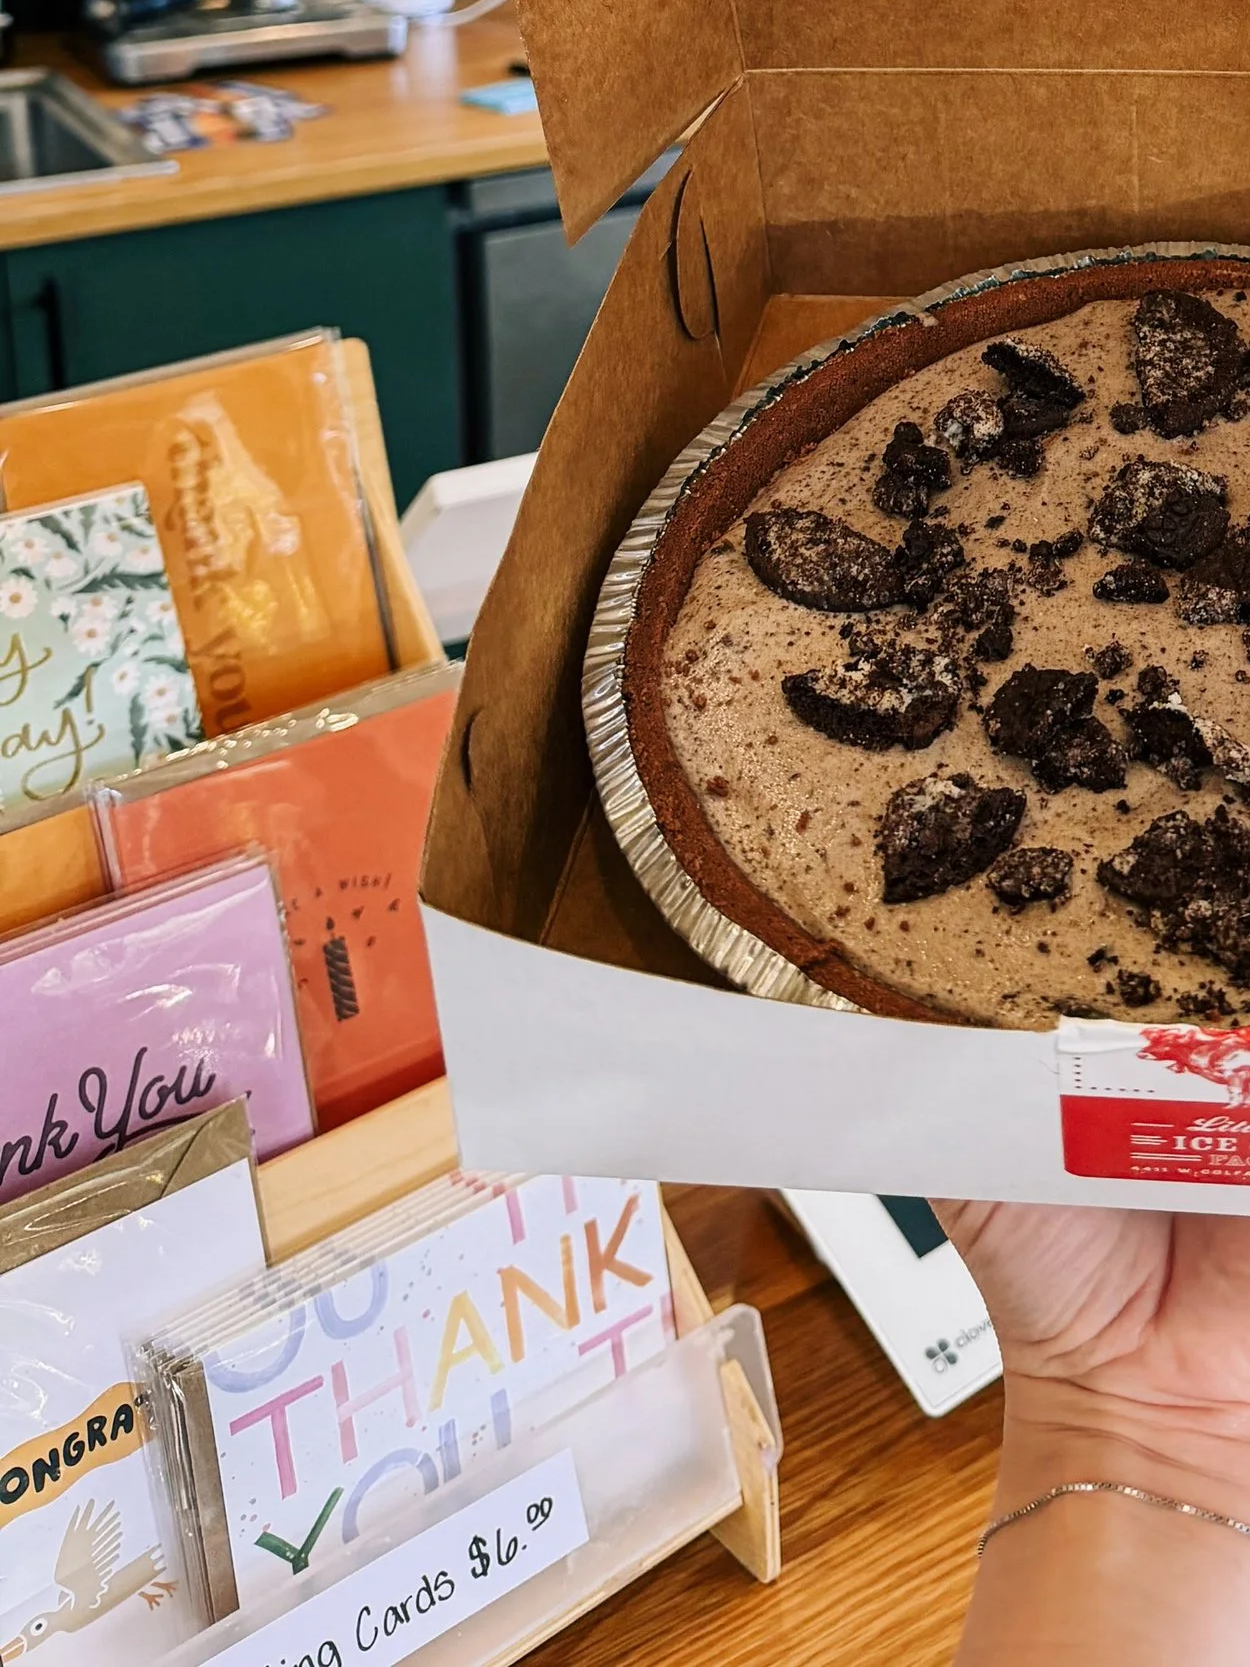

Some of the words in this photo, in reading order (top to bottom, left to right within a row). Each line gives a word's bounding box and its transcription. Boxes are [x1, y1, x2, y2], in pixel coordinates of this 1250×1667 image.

[78, 1046, 216, 1155] You
[1172, 1135, 1238, 1152] ICE
[229, 1192, 655, 1502] THANK
[355, 1569, 456, 1652] Cards
